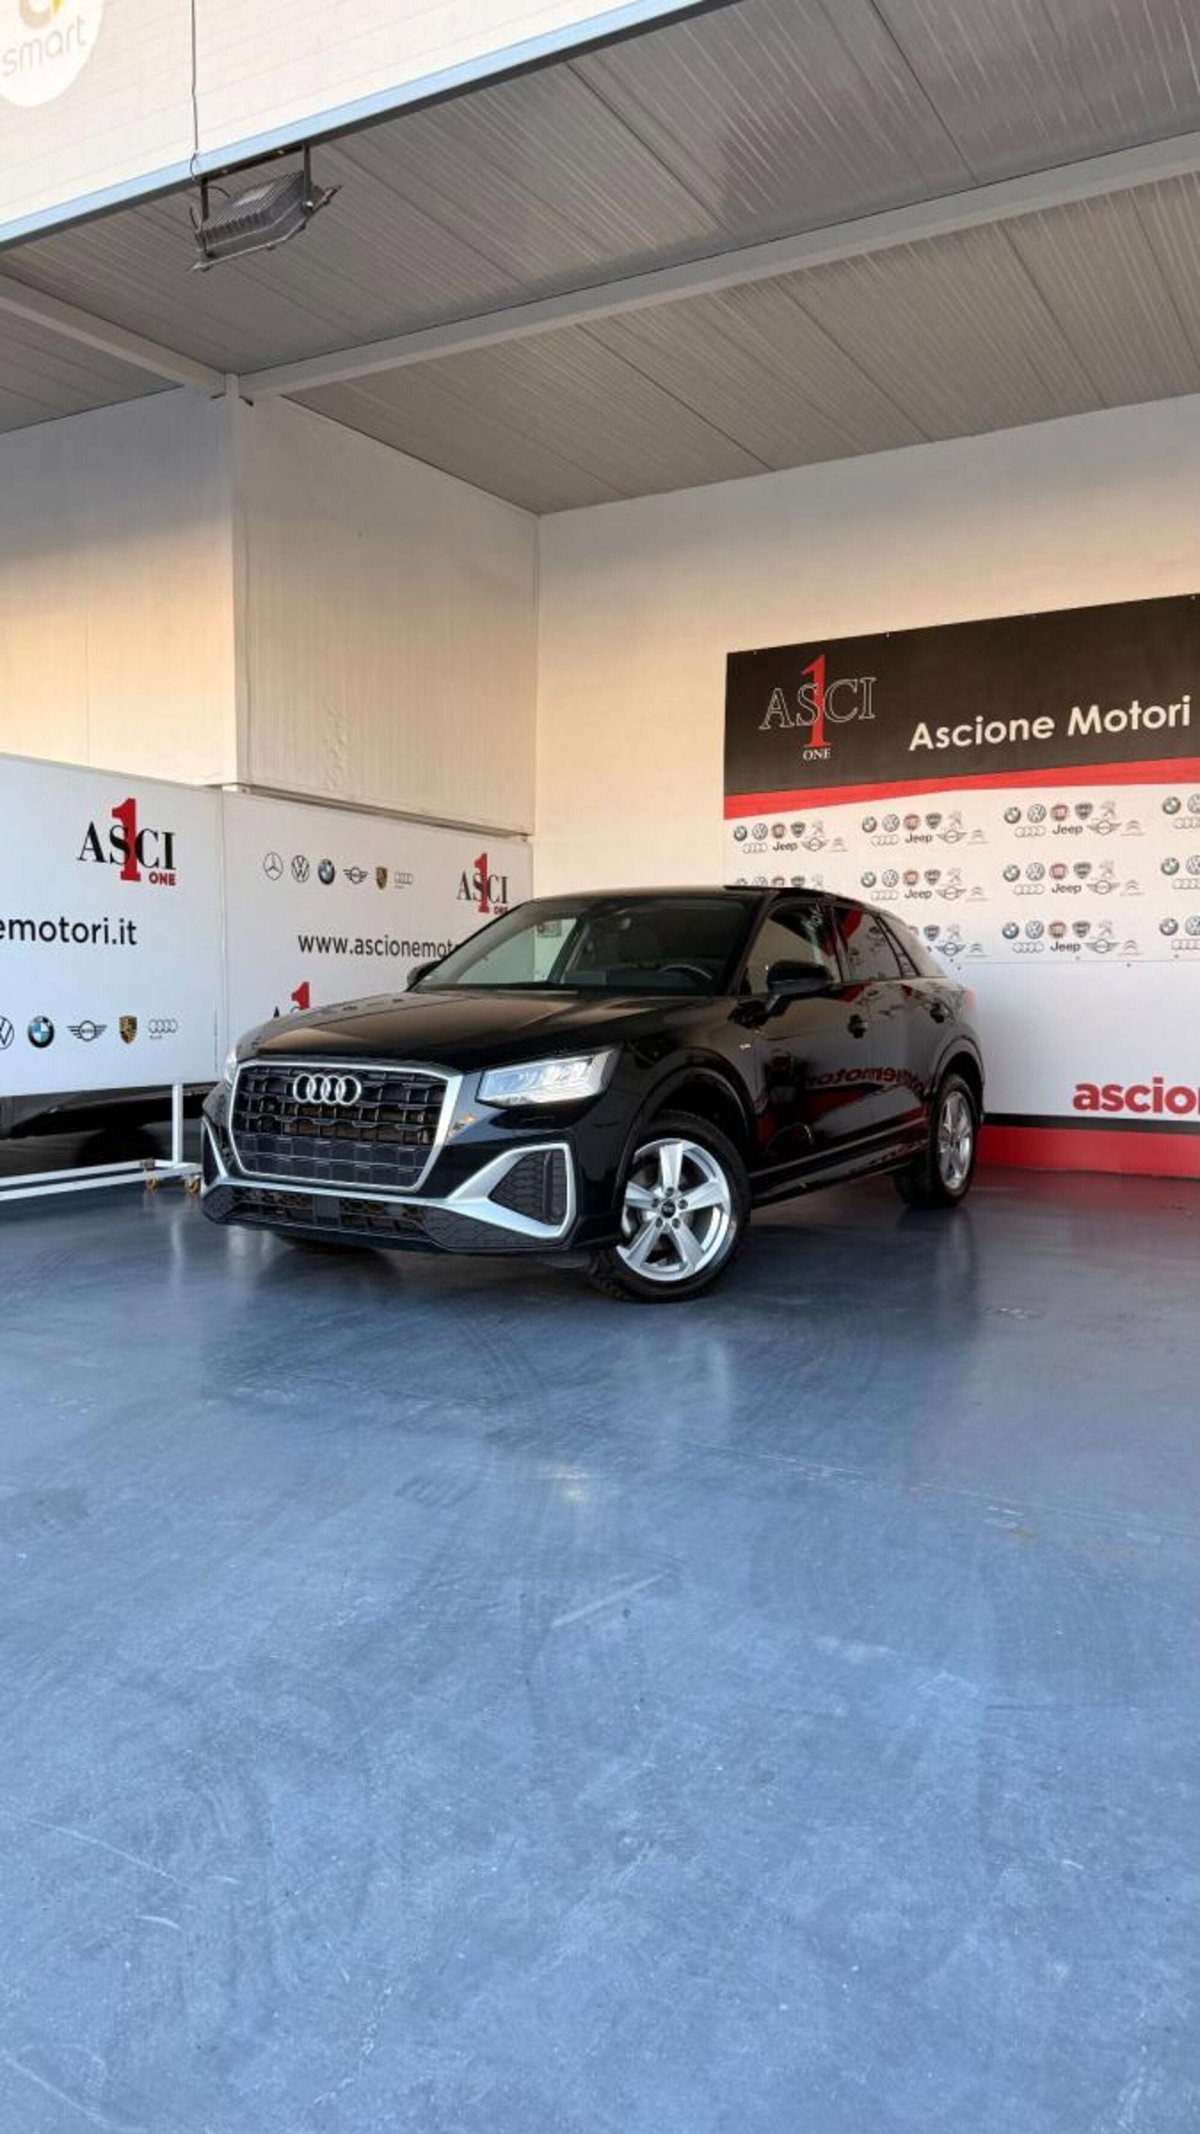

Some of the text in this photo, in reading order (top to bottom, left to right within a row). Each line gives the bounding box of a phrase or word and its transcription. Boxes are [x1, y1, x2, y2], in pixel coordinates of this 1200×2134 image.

[2, 15, 87, 76] smart
[758, 676, 877, 730] ASCI
[909, 695, 1191, 751] Ascione Motori
[802, 747, 831, 760] ONE
[1052, 824, 1084, 836] Jeep
[905, 832, 933, 844] Jeep
[773, 841, 799, 852] Jeep
[149, 871, 176, 886] ONE
[905, 888, 933, 899] Jeep
[1051, 883, 1083, 894] Jeep
[298, 934, 457, 957] www.ascionemot
[1050, 941, 1082, 953] Jeep
[1072, 1077, 1200, 1114] ascio
